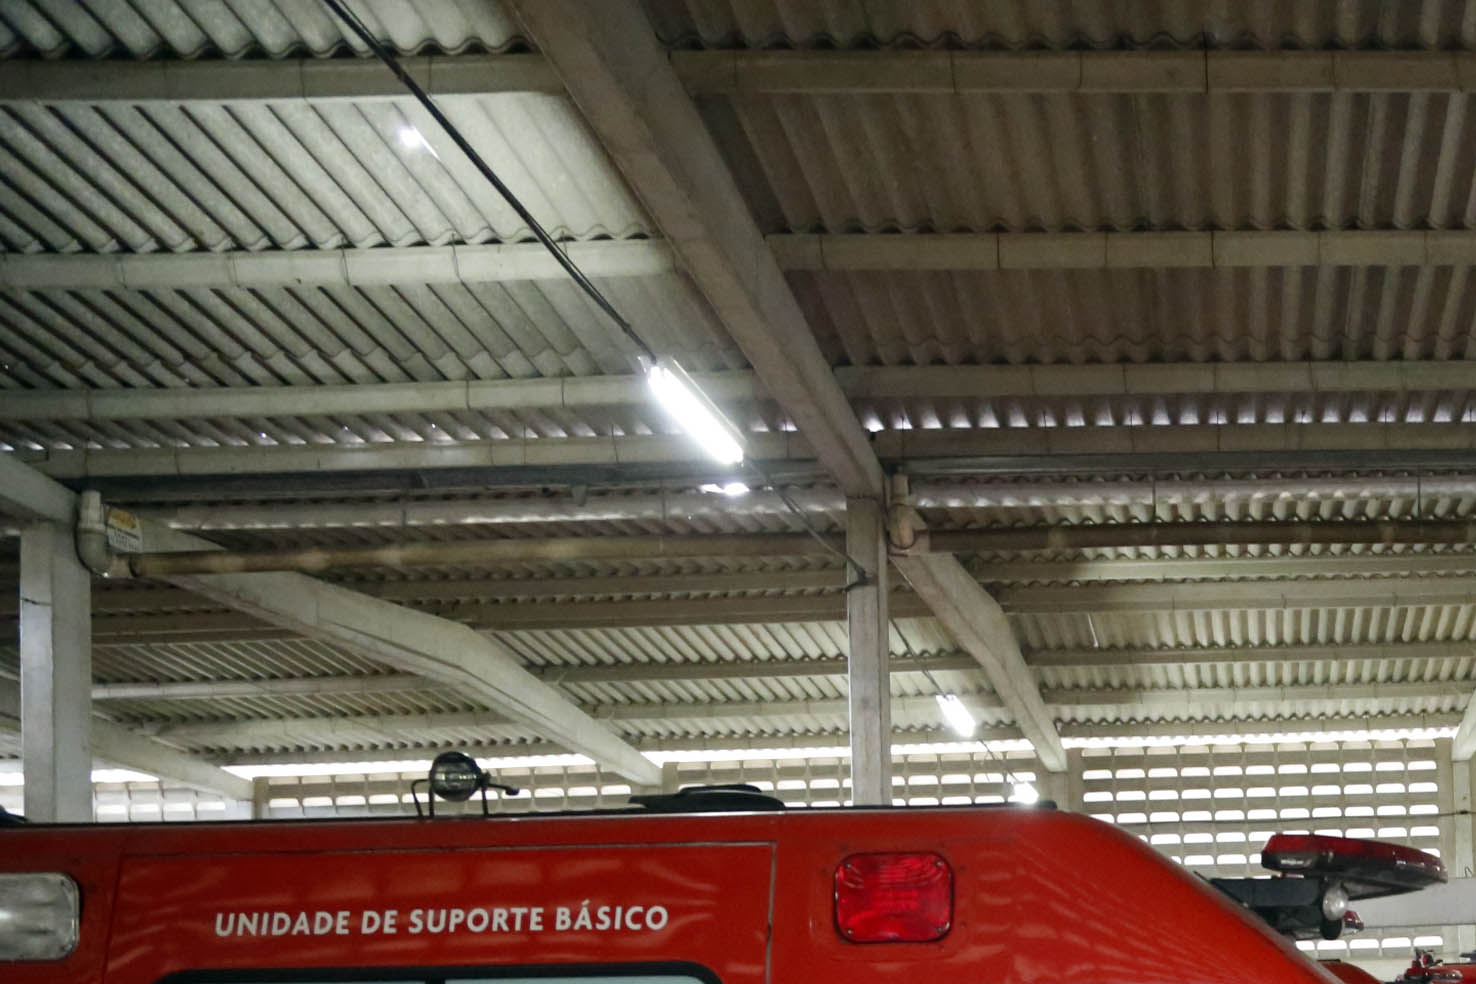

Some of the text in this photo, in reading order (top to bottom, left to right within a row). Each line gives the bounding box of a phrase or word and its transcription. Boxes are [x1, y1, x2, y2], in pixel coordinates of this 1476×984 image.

[214, 899, 669, 937] UNIDADE DE SUPORTE BÁSICO
